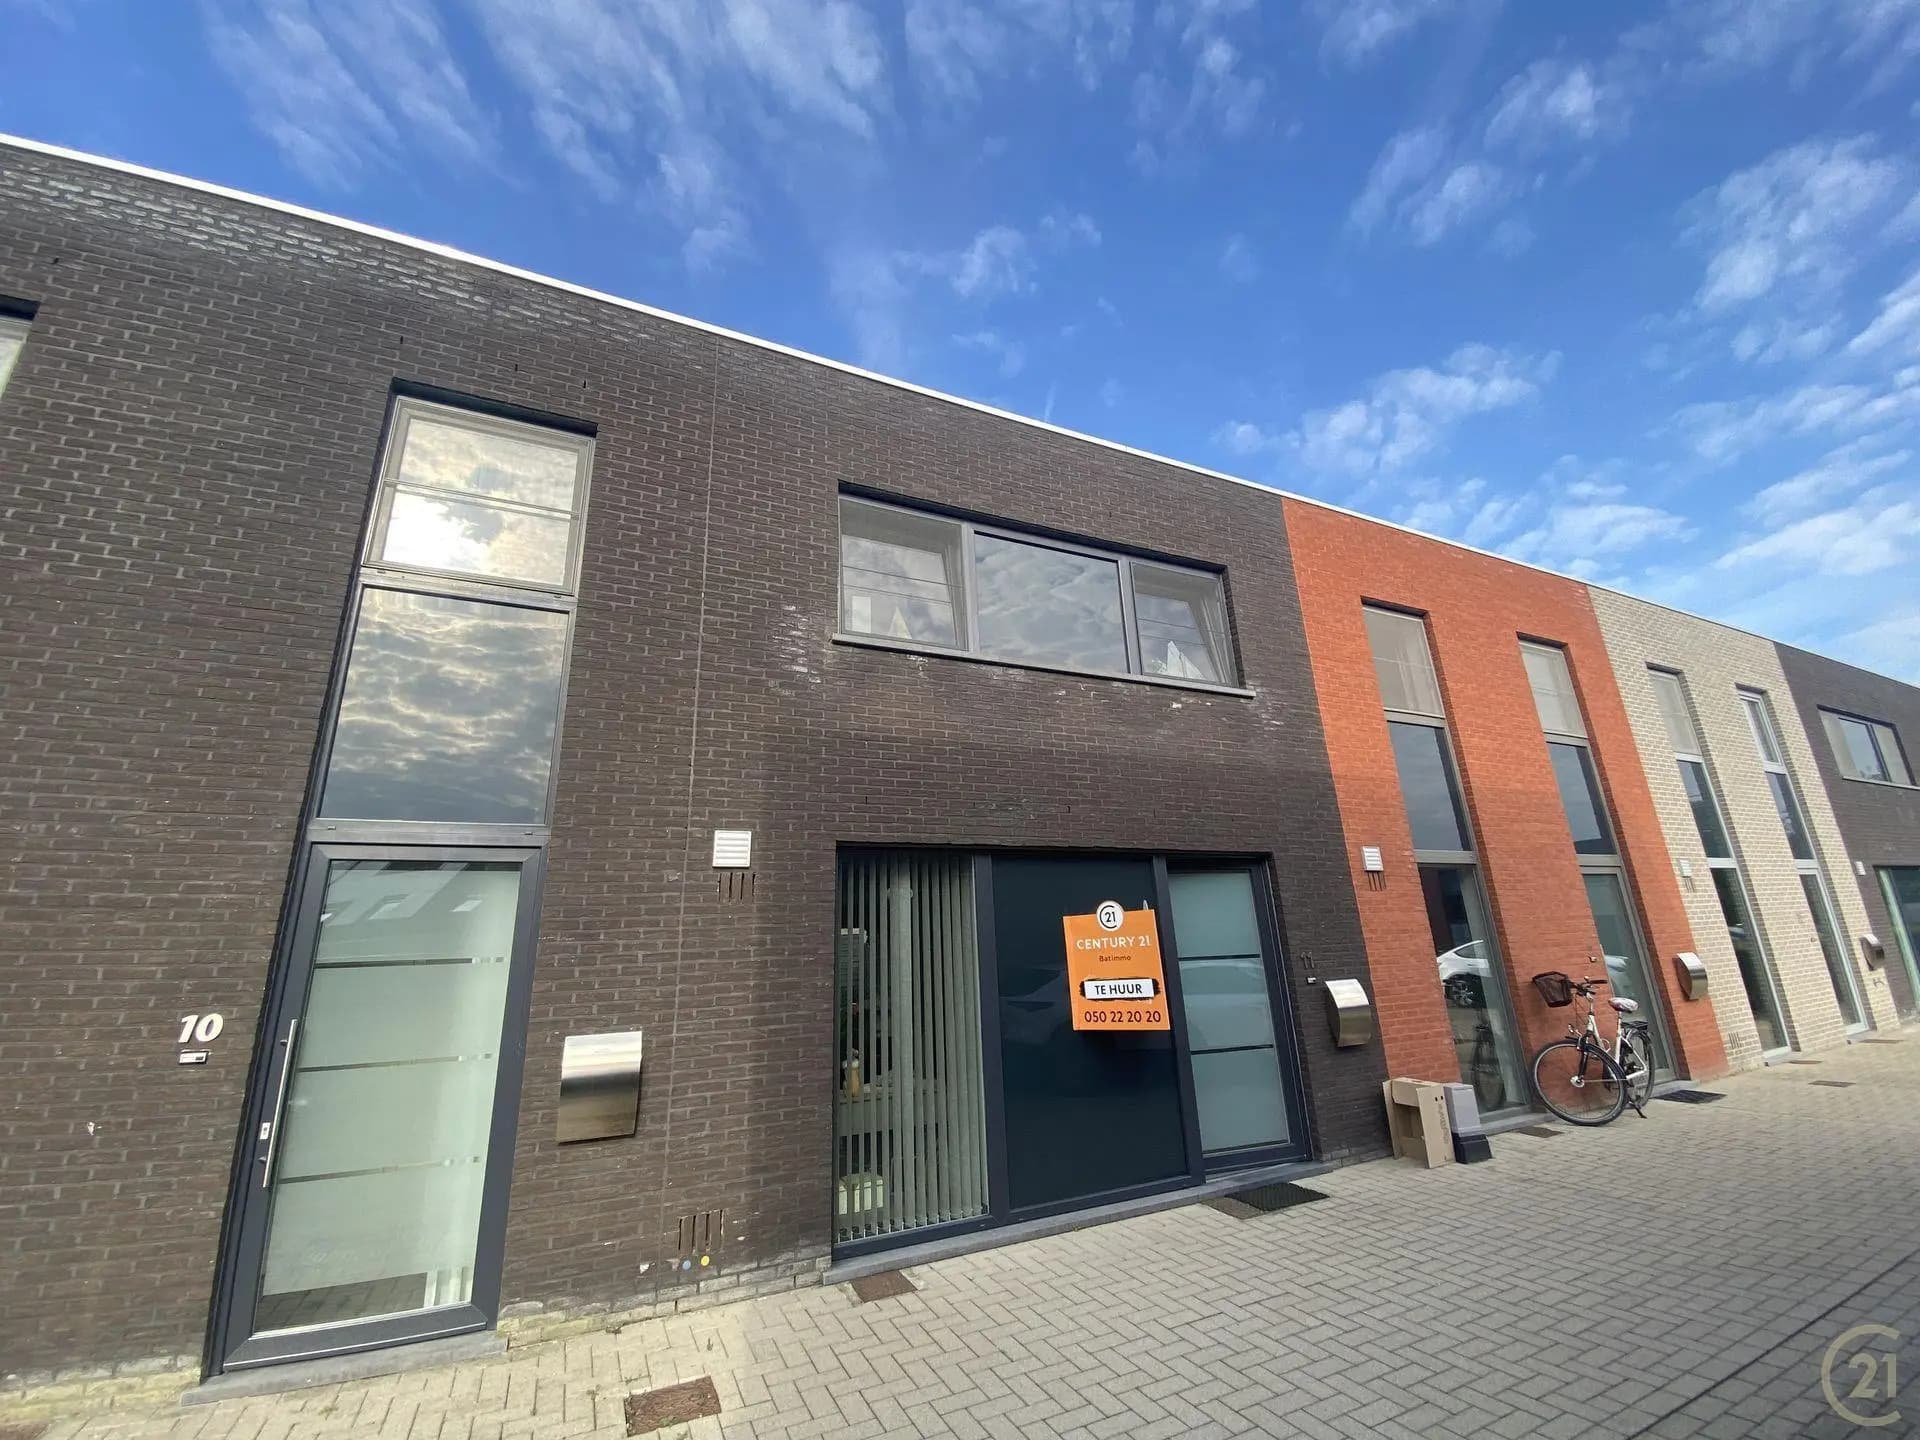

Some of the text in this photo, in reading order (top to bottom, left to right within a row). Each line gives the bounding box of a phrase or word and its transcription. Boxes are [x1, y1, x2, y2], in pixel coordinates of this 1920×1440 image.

[1076, 935, 1151, 949] CENTURY 21
[1094, 983, 1143, 995] TE HUUR
[1084, 1010, 1161, 1023] 050 22 20 20
[178, 1013, 224, 1043] 10
